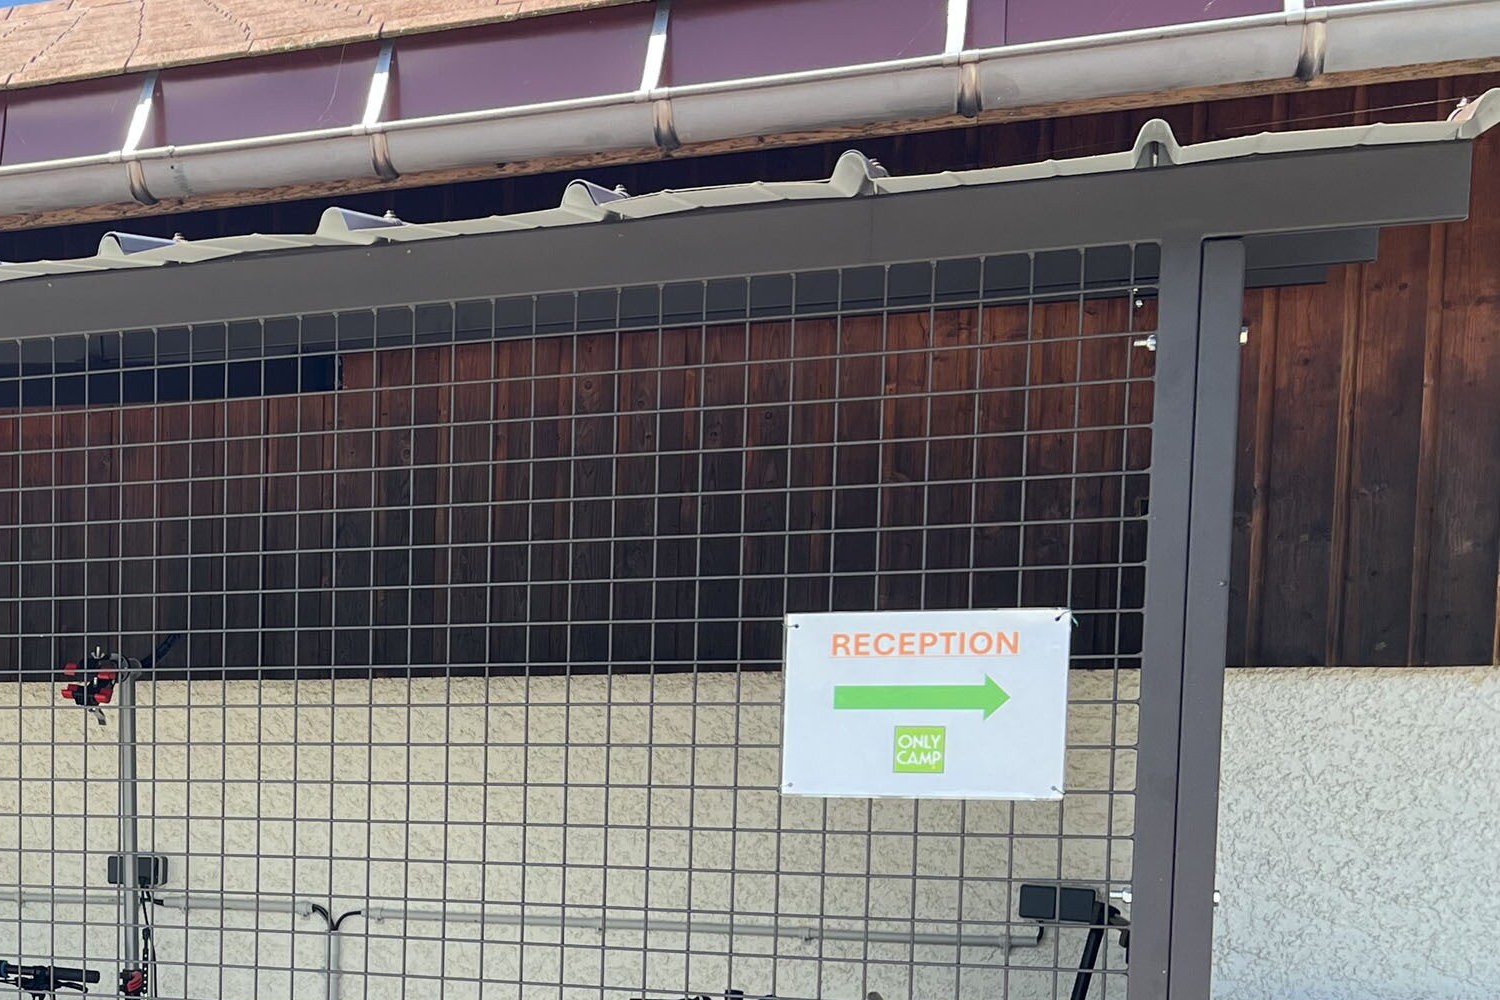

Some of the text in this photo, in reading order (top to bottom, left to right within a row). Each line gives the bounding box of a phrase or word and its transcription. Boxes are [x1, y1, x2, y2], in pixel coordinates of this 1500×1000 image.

[831, 631, 1020, 656] RECEPTION
[897, 734, 942, 750] ONLY
[896, 750, 942, 766] CAMP
